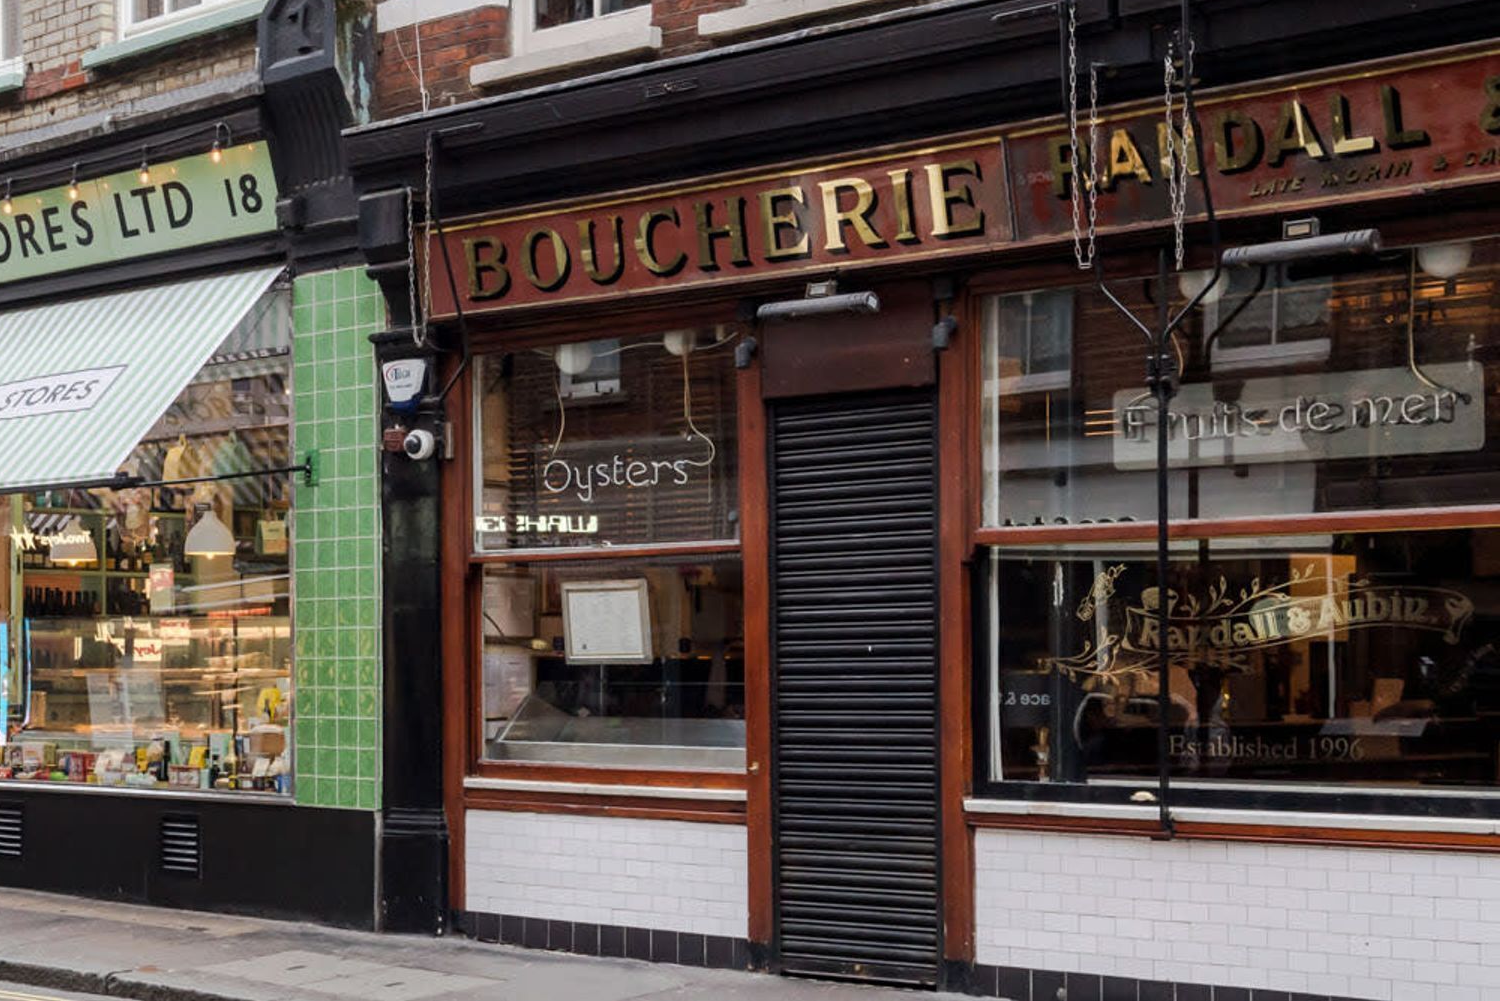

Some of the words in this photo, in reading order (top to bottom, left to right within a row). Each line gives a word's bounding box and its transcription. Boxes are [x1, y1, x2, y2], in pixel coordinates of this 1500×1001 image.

[1045, 86, 1428, 197] RANDALL
[1250, 177, 1304, 198] LATE
[1321, 161, 1413, 188] MORIN
[113, 180, 194, 239] LTD
[224, 173, 263, 217] 18
[464, 160, 986, 299] BOUCHERIE
[1279, 396, 1333, 433] de
[1351, 390, 1458, 427] mer
[543, 455, 688, 501] Oysters
[1286, 605, 1312, 635] &
[1168, 734, 1298, 761] Established
[1307, 737, 1363, 762] 1996
